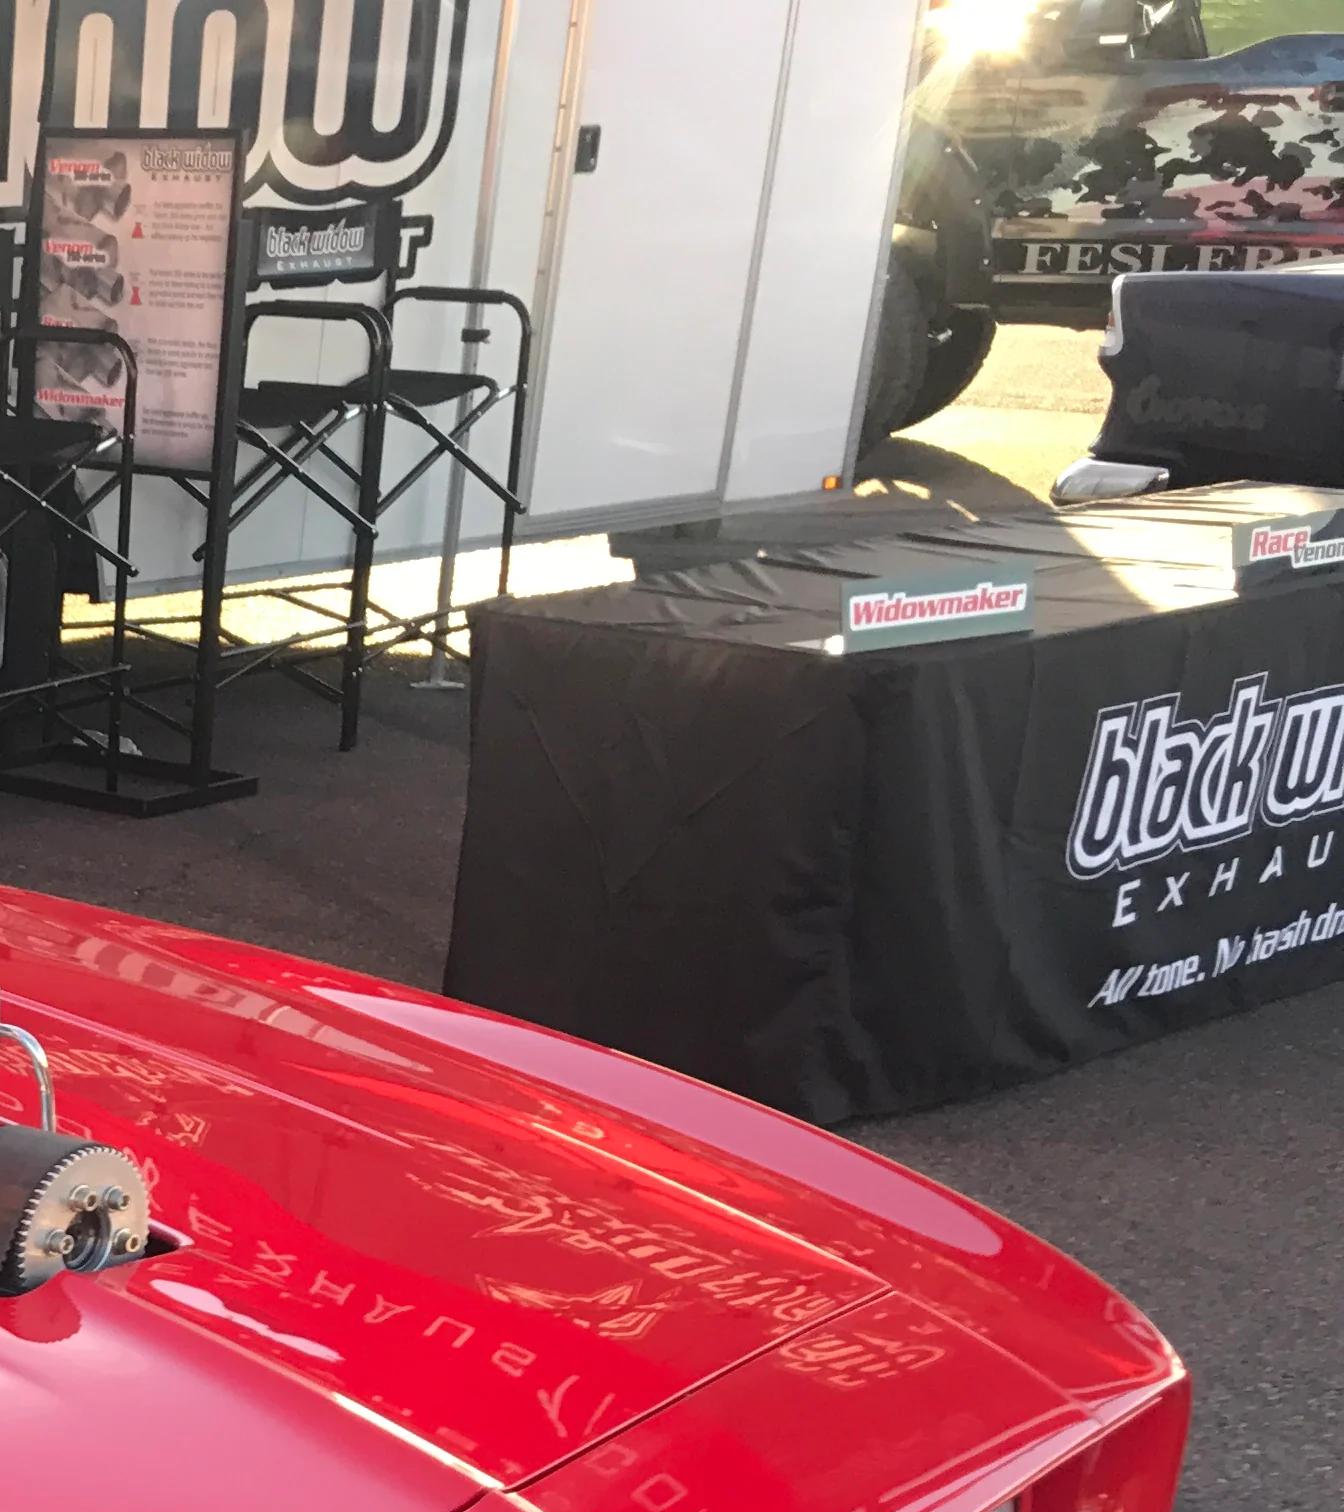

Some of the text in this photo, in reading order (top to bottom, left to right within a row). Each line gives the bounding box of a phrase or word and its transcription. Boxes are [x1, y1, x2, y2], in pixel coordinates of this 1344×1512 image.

[267, 226, 310, 257] black
[311, 217, 365, 255] widow
[277, 257, 353, 271] EXHAUST
[37, 388, 126, 409] Widowmaker
[1251, 530, 1309, 558] Race
[852, 586, 1025, 628] Widowmaker
[1066, 672, 1276, 880] black
[1087, 964, 1144, 1008] All
[1137, 954, 1206, 997] tone.
